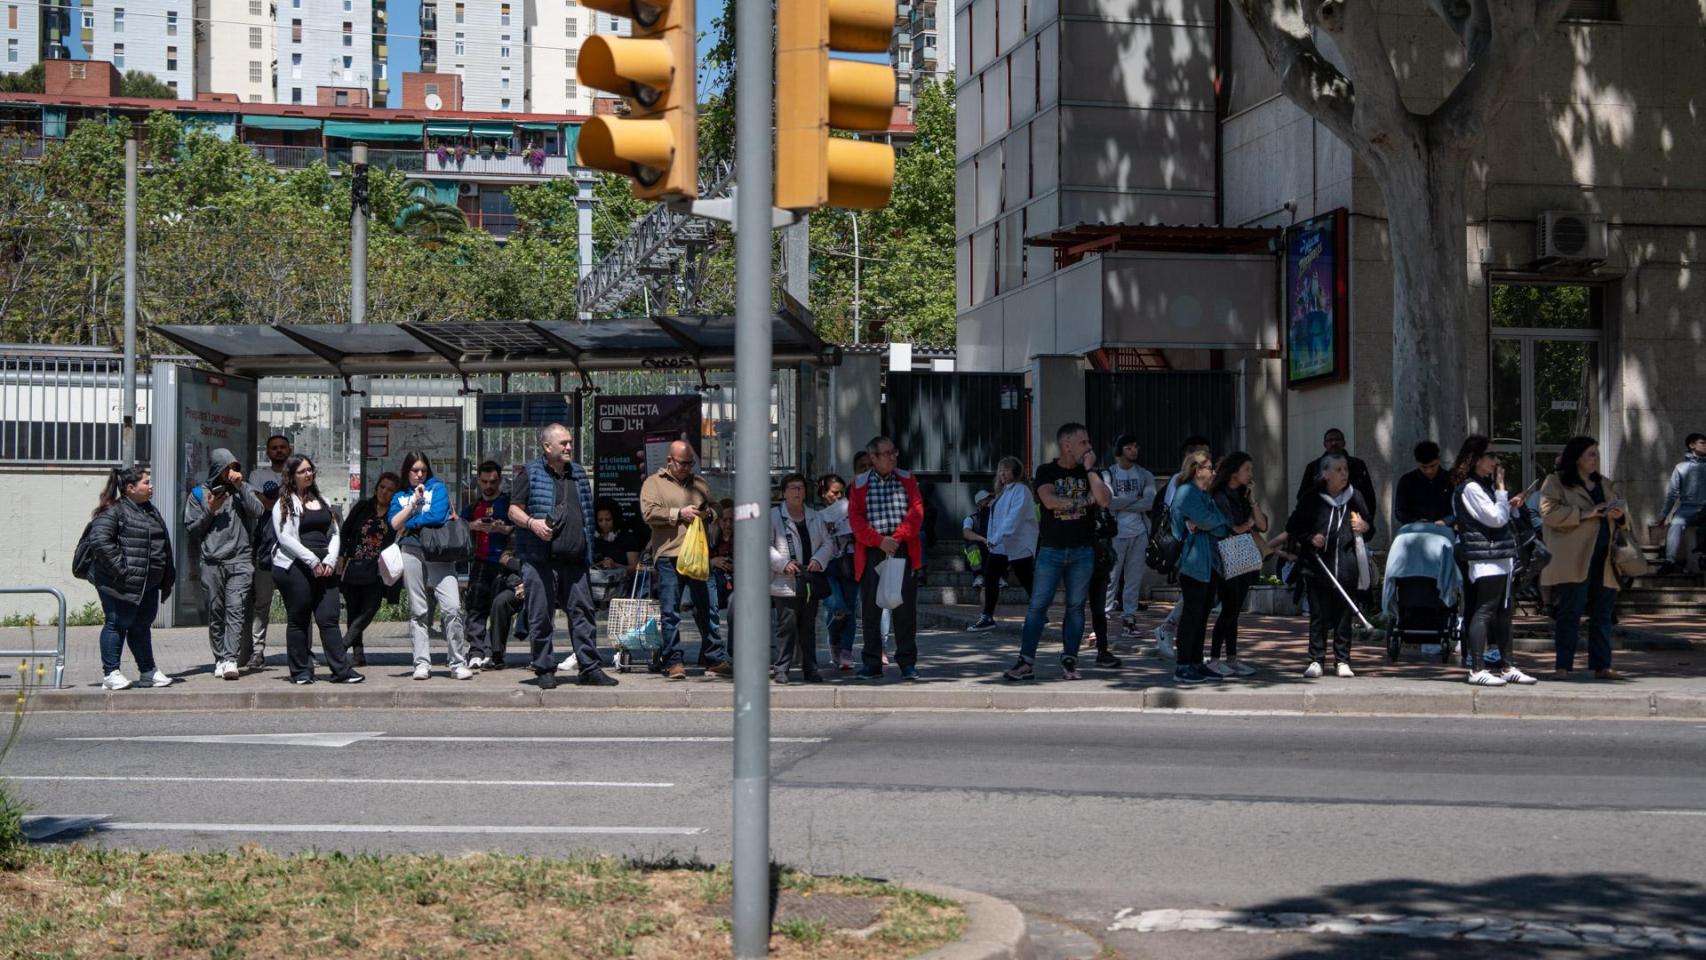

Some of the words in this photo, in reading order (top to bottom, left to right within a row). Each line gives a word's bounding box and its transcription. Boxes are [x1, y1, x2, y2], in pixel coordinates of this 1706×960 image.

[599, 404, 660, 416] CONNECTA
[627, 419, 644, 430] L'H
[609, 455, 631, 463] ciutat
[605, 463, 616, 471] les
